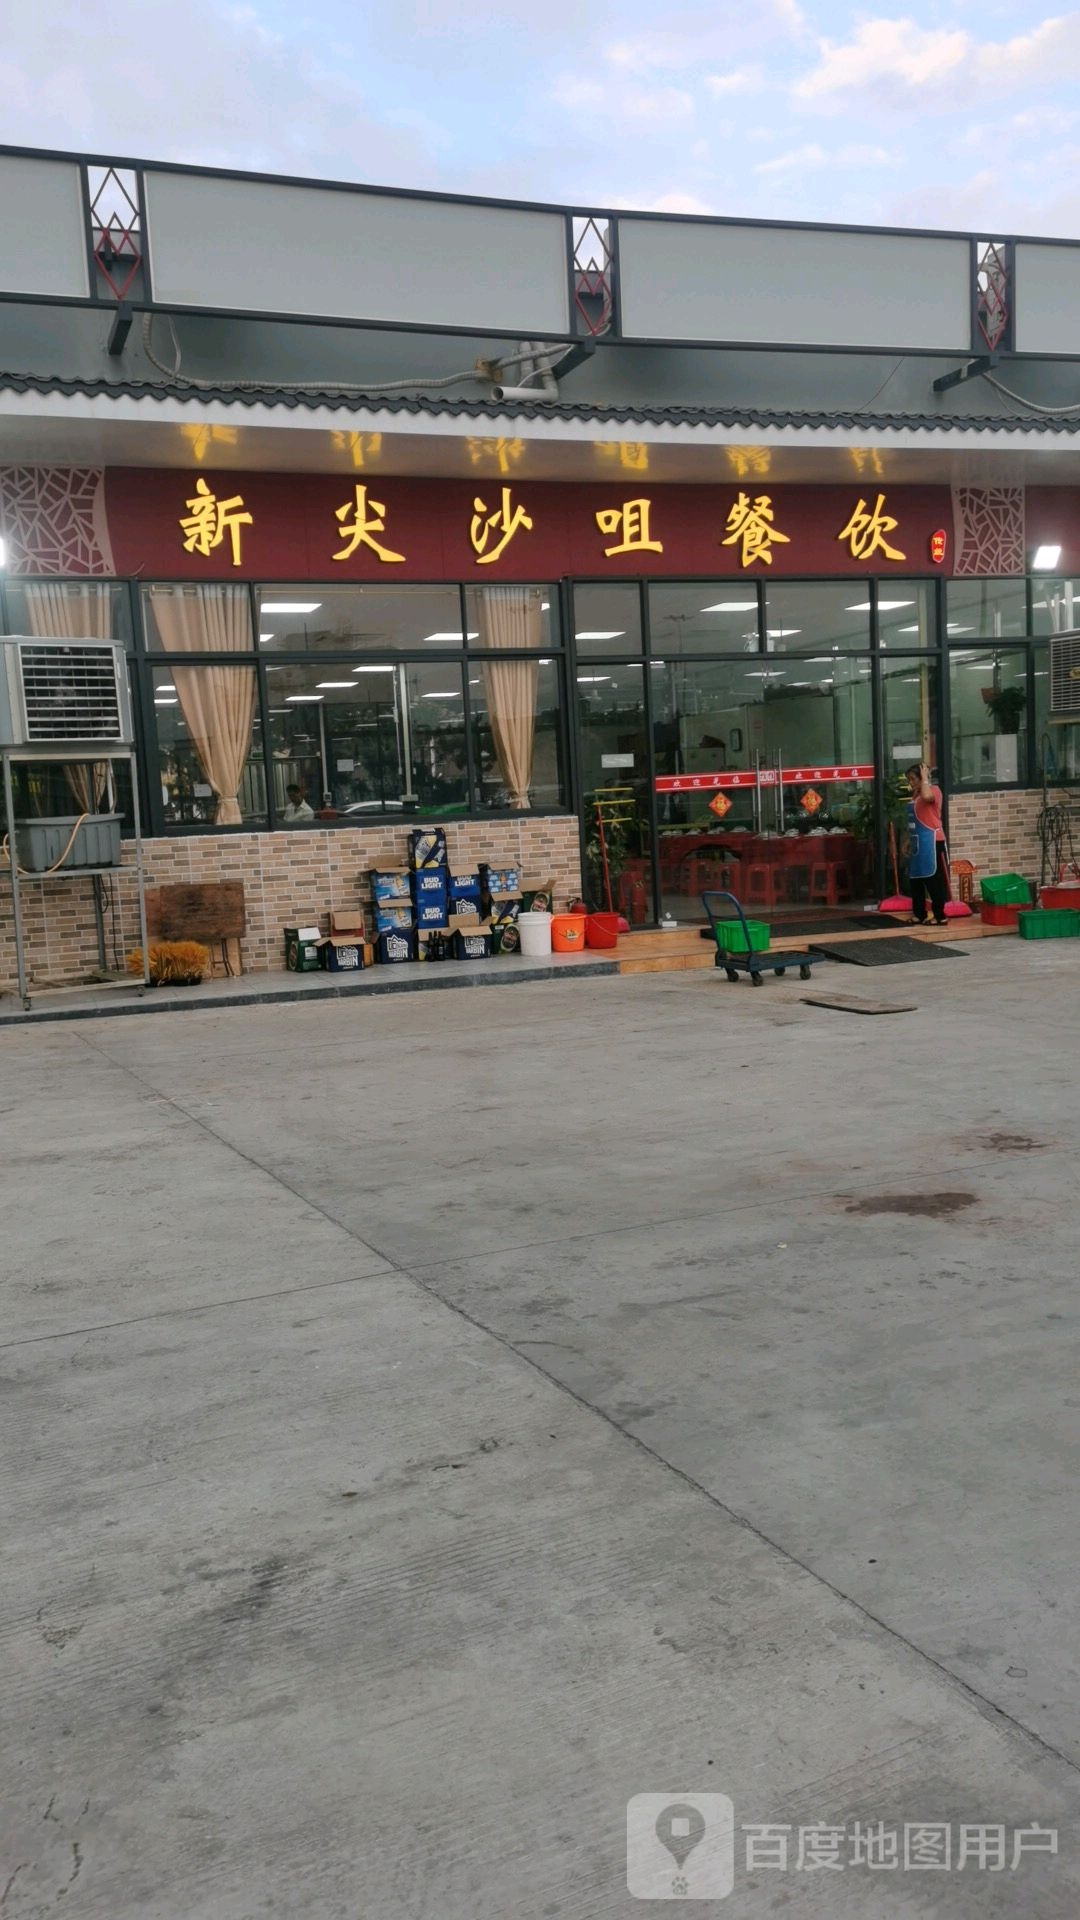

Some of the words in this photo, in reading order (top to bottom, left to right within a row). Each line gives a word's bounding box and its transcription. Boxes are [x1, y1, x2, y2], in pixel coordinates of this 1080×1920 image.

[179, 477, 907, 568] 新尖沙咀餐饮
[795, 768, 859, 779] 欢迎光临
[673, 775, 740, 787] 欢迎光临
[423, 876, 440, 884] BUD
[454, 878, 475, 887] LIGHT
[424, 907, 441, 915] BUD
[422, 912, 443, 920] LIGHT
